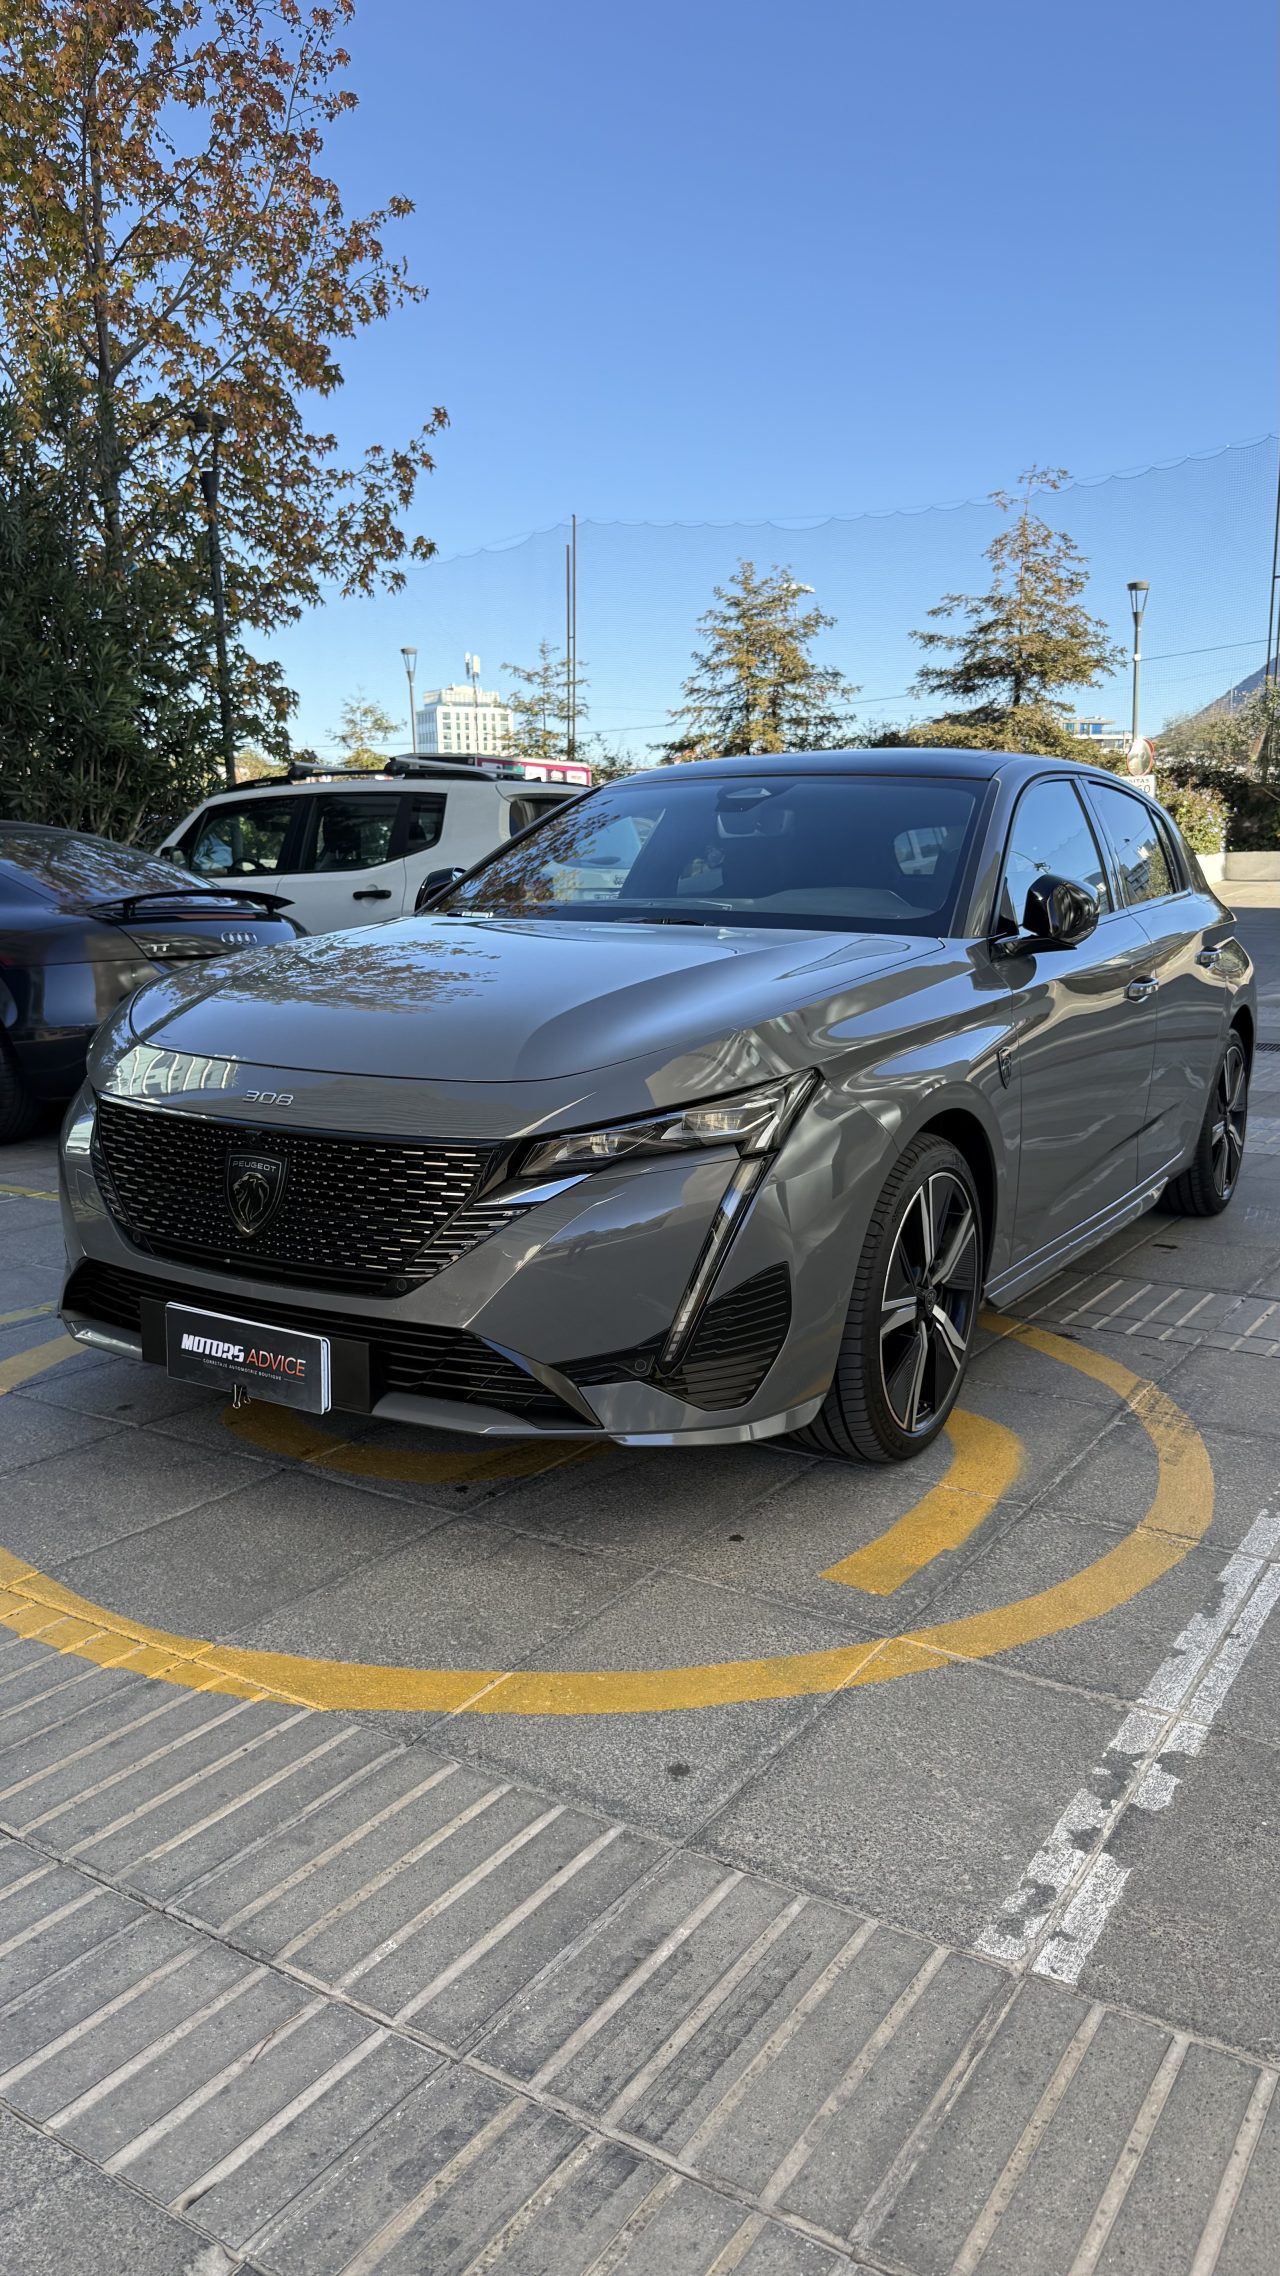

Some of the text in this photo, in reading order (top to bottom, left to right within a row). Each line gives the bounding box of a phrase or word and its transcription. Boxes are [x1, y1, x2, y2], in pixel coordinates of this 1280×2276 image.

[150, 943, 170, 952] TT
[242, 1090, 294, 1106] 308
[232, 1160, 276, 1172] PEUGEOT
[181, 1333, 306, 1377] MOTORS ADVICE
[203, 1358, 282, 1381] CORRETAJE AUTOMOTRIZ BOUTIQUE
